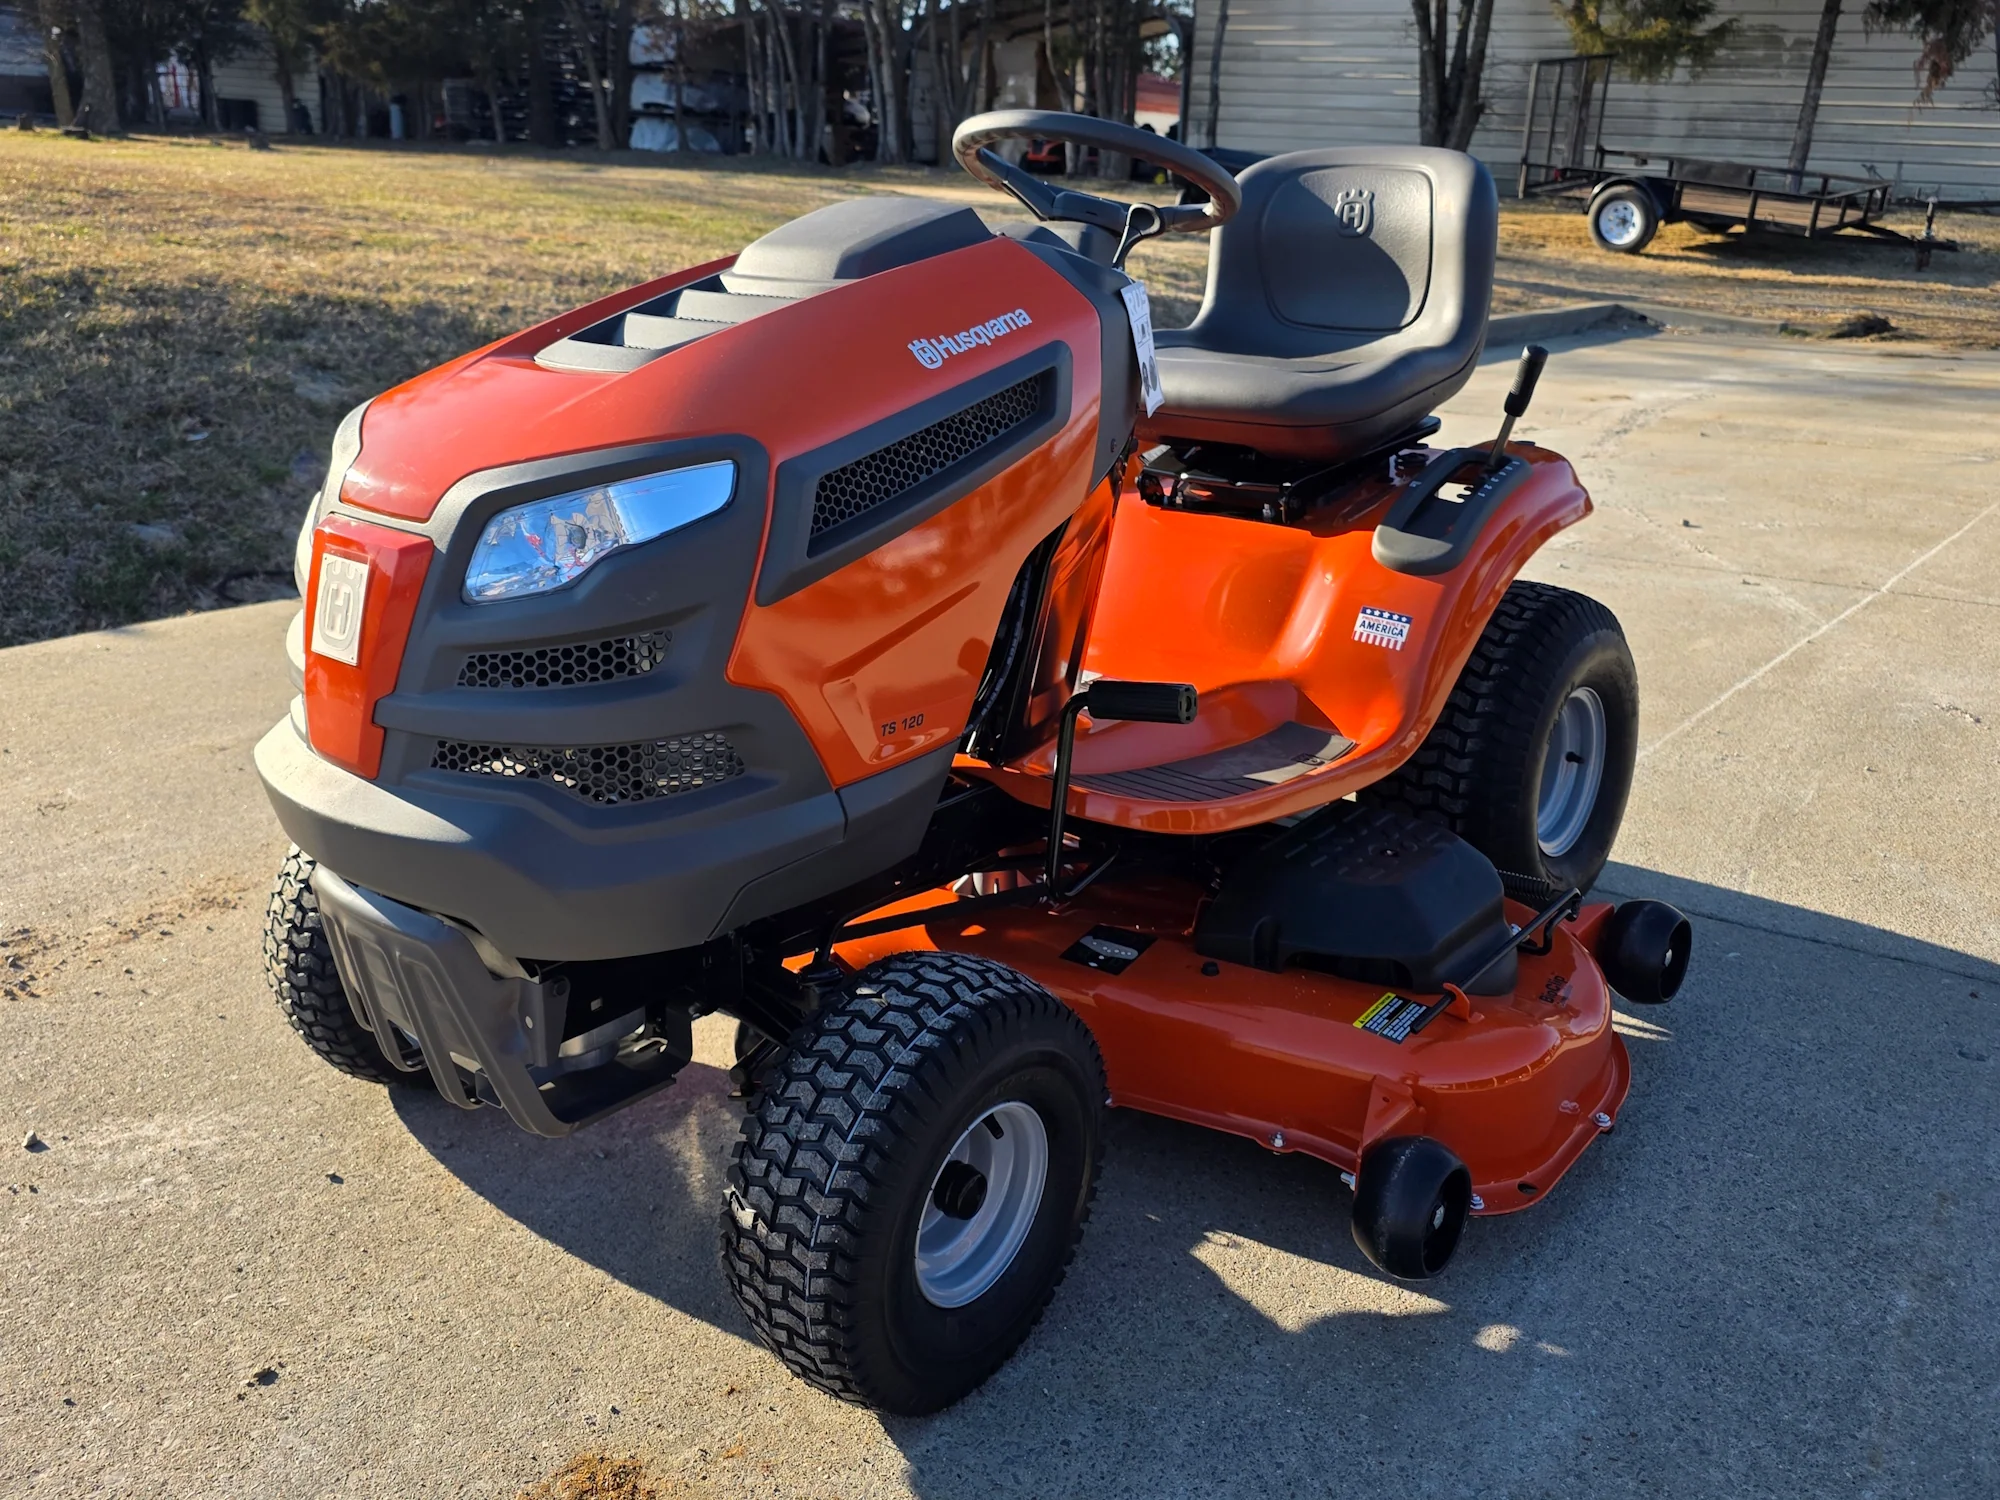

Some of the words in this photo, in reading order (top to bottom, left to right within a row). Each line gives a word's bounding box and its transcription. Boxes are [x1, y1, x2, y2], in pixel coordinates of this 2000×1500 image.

[930, 308, 1033, 359] Husqvarna
[1358, 619, 1404, 638] AMERICA
[881, 721, 897, 737] TS
[901, 713, 924, 731] 120
[1538, 975, 1568, 1004] BioClip
